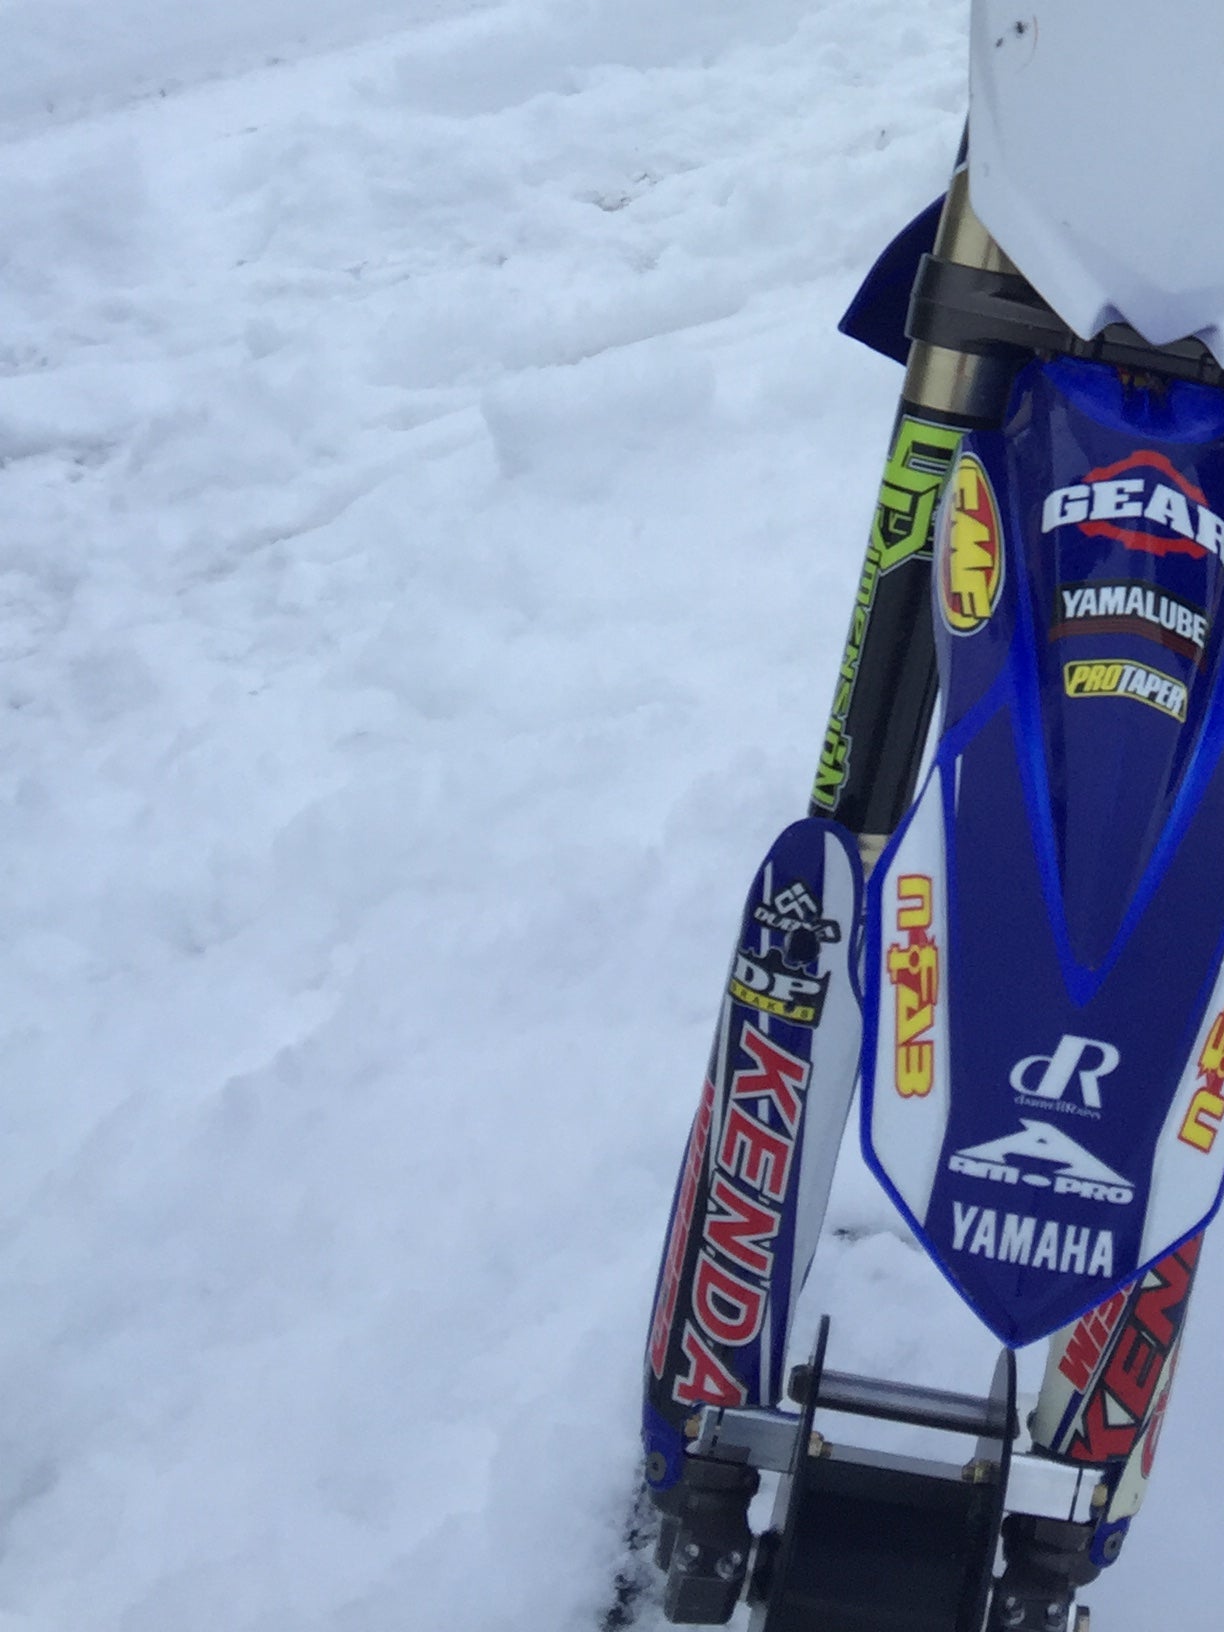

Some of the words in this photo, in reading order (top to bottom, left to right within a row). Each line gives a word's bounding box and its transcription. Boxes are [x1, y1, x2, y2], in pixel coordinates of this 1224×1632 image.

[1061, 585, 1210, 650] YAMALUBE
[732, 980, 813, 1019] BRAKS
[735, 953, 821, 1001] DP
[672, 1020, 811, 1408] KENDA
[952, 1200, 1115, 1279] YAMAHA
